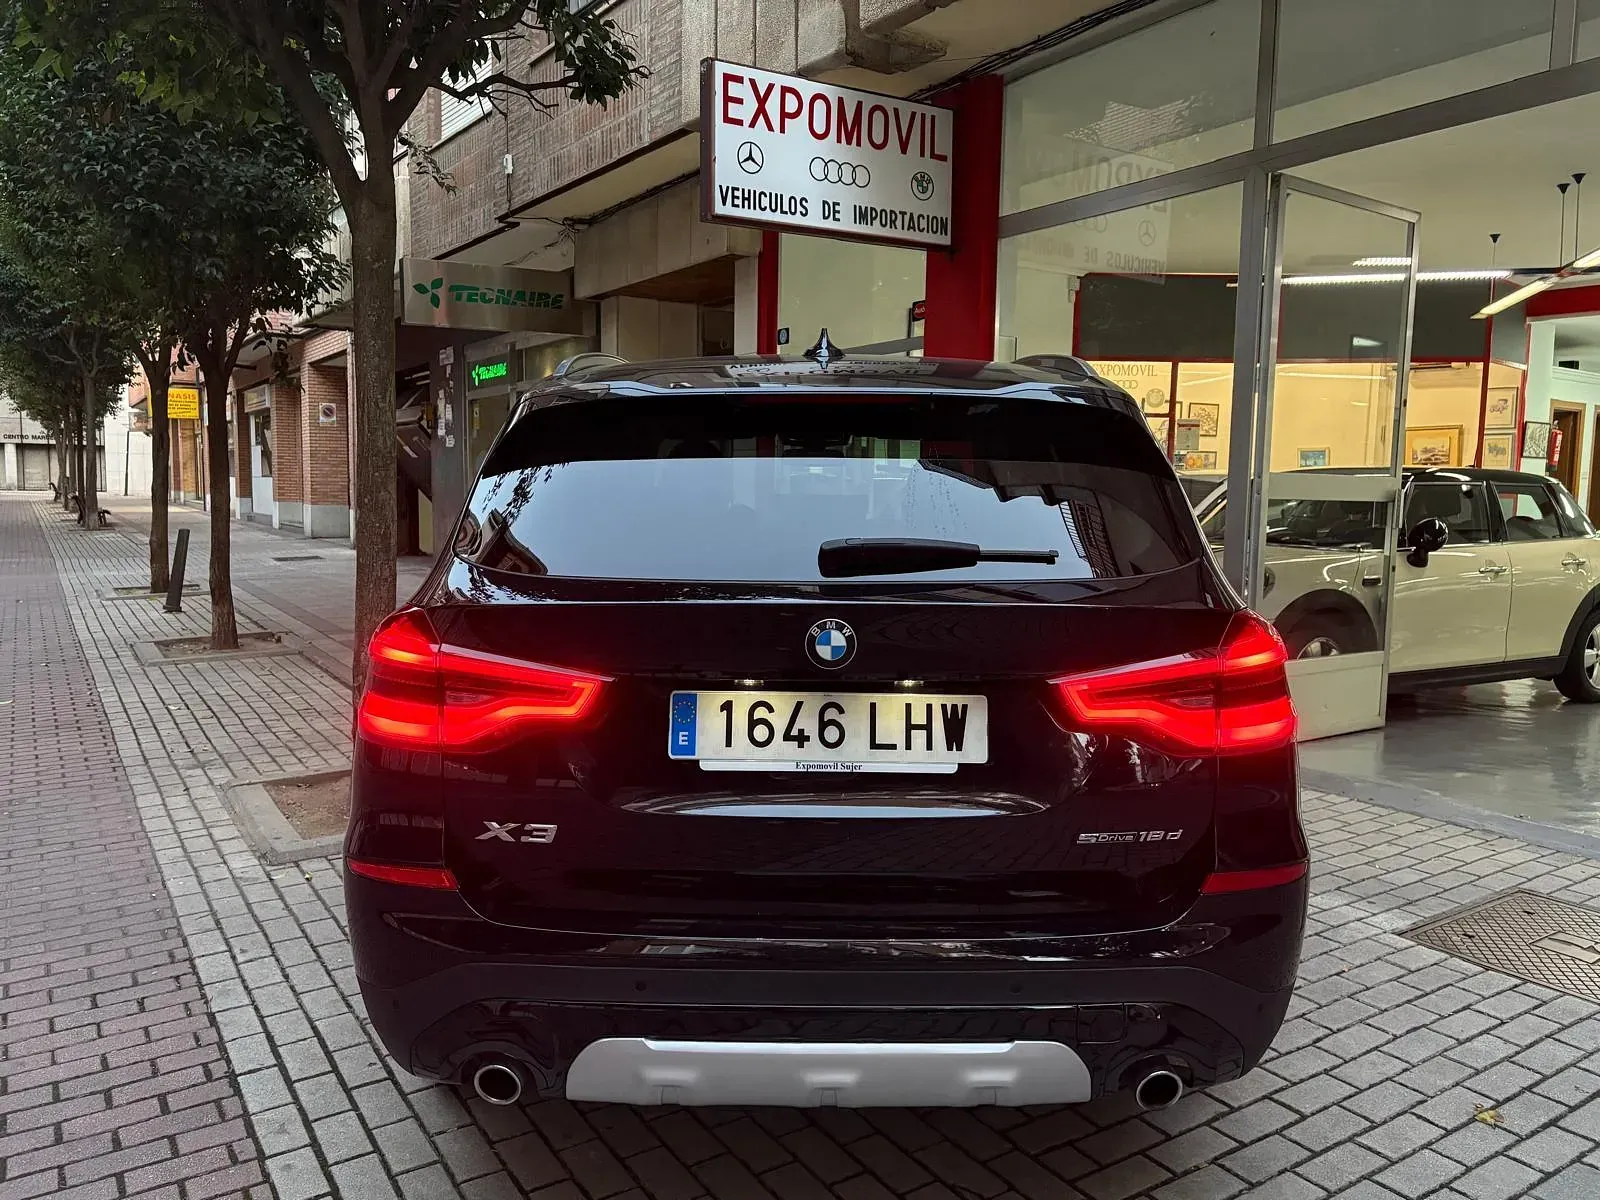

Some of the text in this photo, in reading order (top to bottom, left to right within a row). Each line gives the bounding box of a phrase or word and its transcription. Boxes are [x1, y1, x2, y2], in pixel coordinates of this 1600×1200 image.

[722, 72, 948, 162] EXPOMOVIL
[719, 184, 949, 236] VEHICULOS DE IMPORTACION
[448, 284, 565, 309] TECNAIRE
[811, 621, 852, 637] BMW
[719, 700, 969, 752] 1646 LHW
[678, 732, 689, 745] E
[795, 761, 863, 772] Expomovil Sujer
[474, 821, 558, 844] X3
